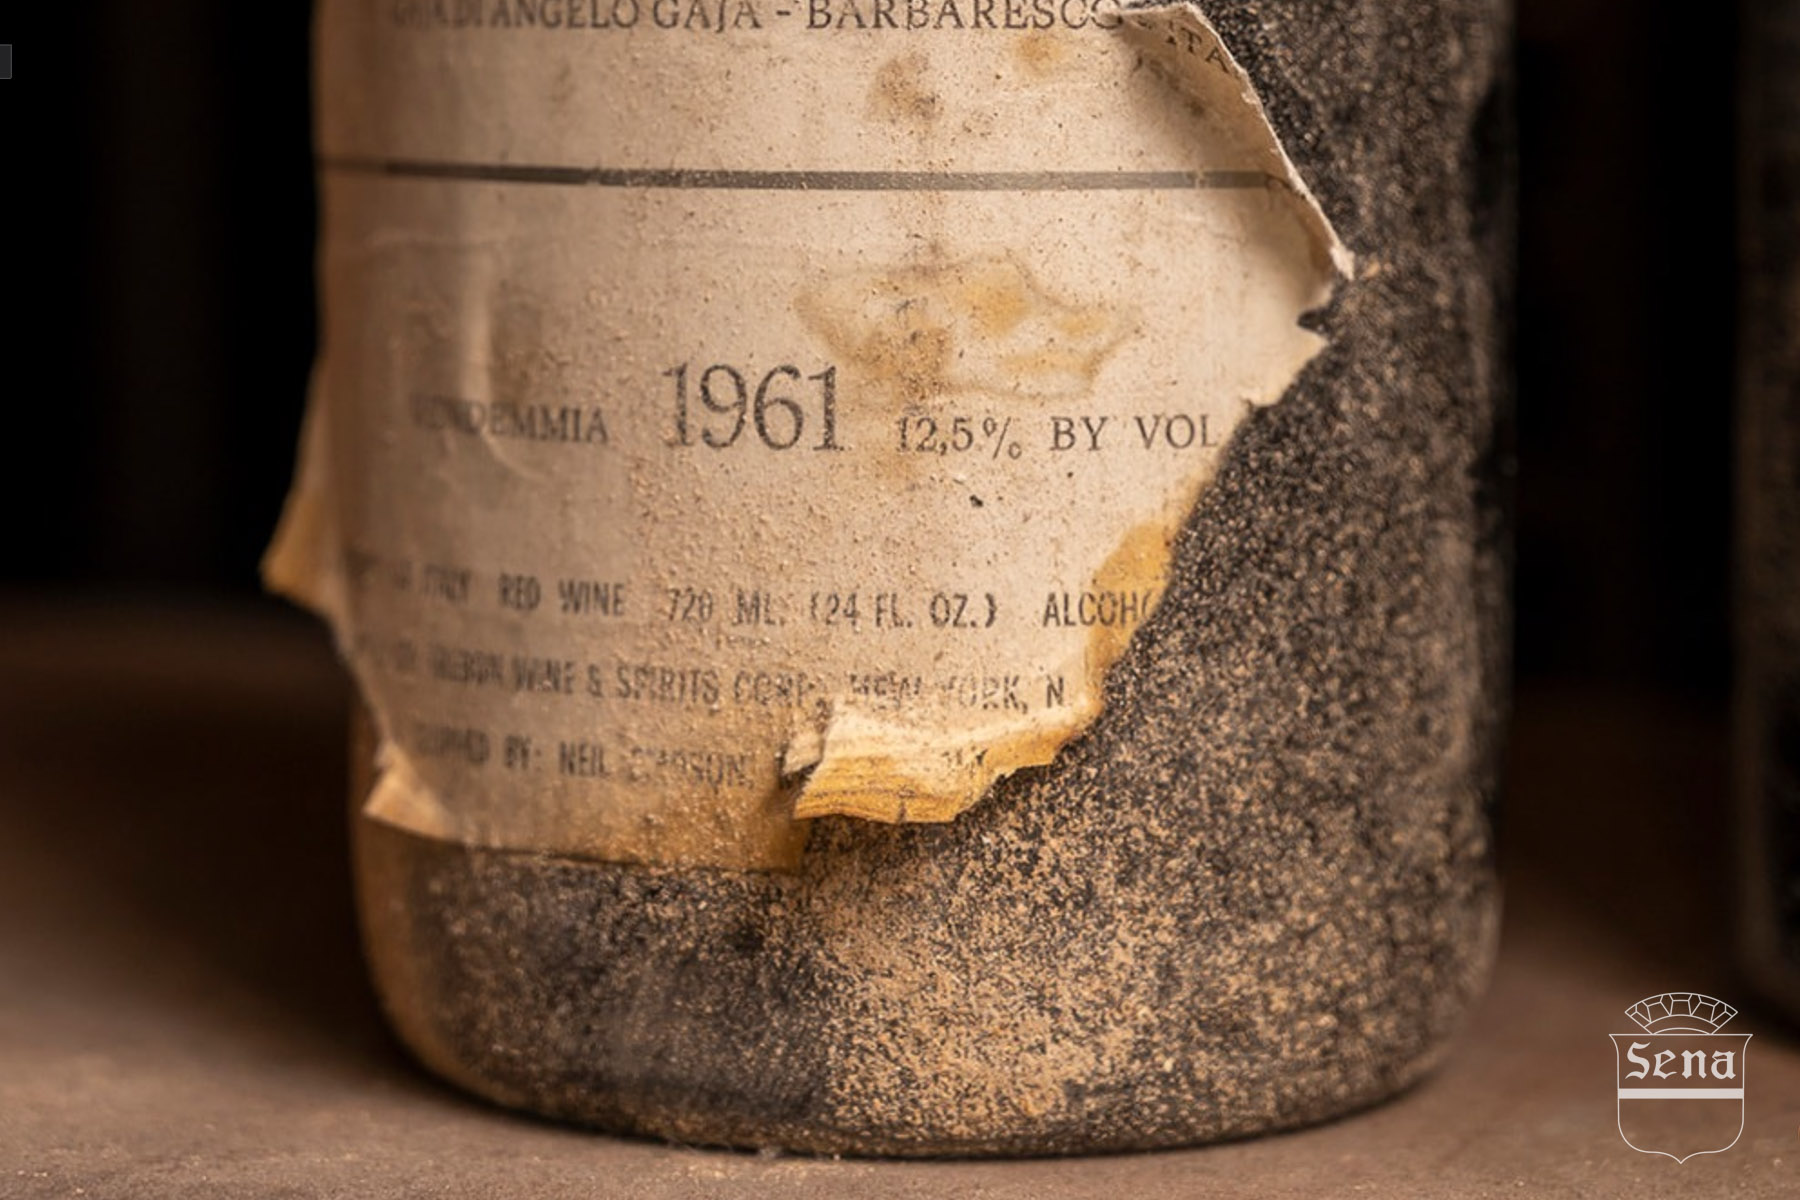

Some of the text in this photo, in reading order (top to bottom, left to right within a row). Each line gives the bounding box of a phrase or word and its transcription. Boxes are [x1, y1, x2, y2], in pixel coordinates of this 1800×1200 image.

[662, 361, 844, 453] 1961
[895, 415, 1023, 461] 12,5%
[1049, 415, 1109, 452] BY
[500, 572, 542, 615] RED
[558, 580, 627, 618] WINE
[929, 591, 998, 629] OZ.)
[513, 655, 574, 694] WINE
[616, 664, 720, 704] SPIRITS
[558, 740, 609, 778] NEIL
